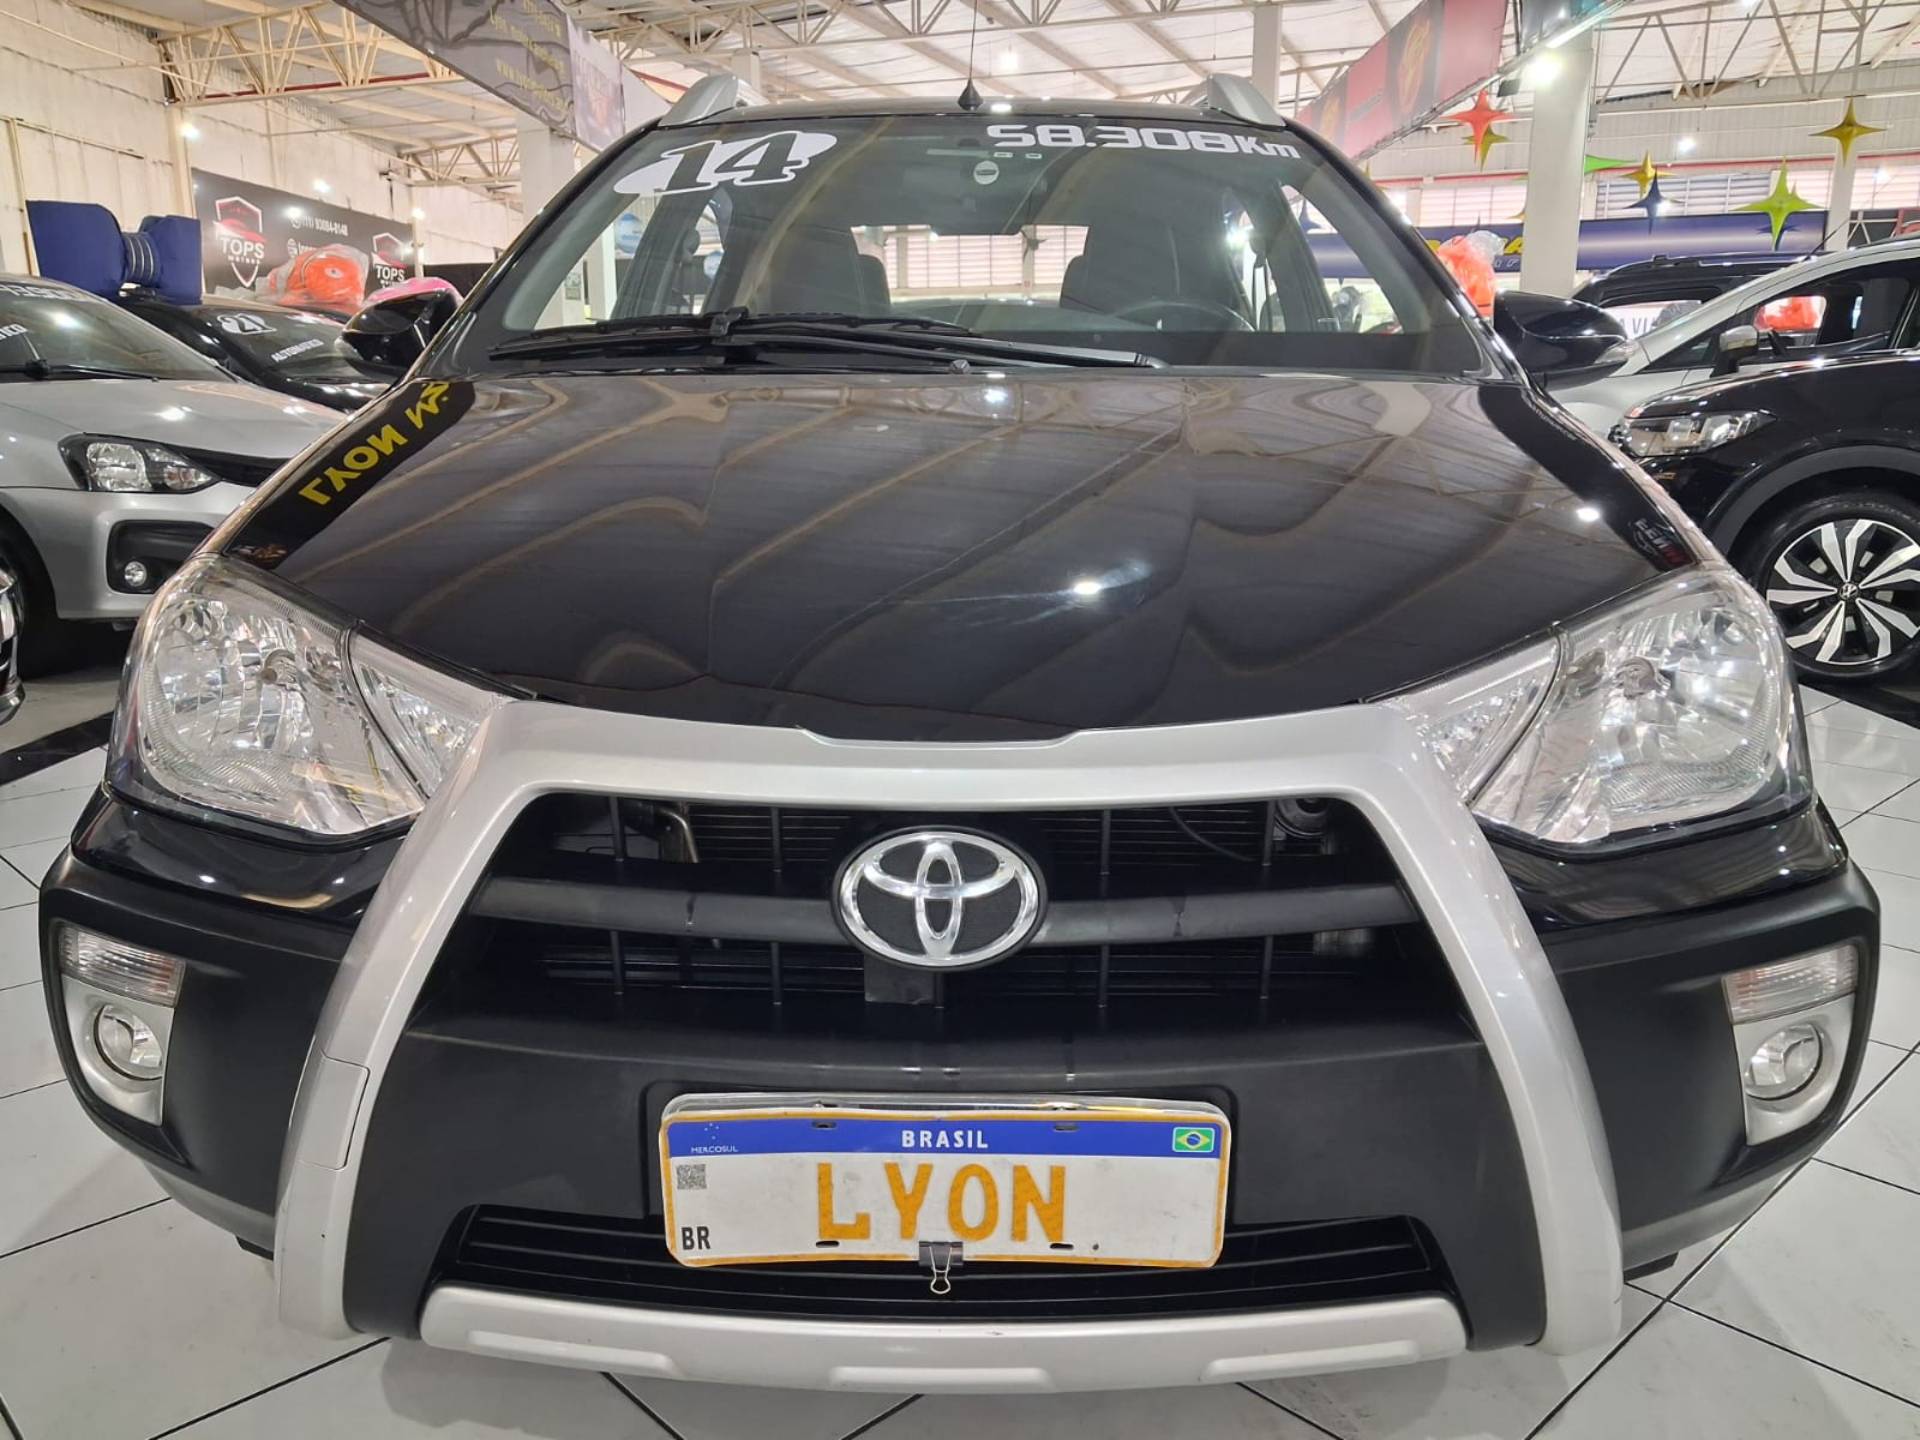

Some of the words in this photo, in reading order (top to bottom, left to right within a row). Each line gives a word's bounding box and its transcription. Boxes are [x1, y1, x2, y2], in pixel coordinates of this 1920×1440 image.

[987, 125, 1301, 158] 58.308Km
[655, 131, 812, 195] 14
[220, 236, 264, 259] TOPS
[376, 265, 405, 282] TOPS
[217, 313, 277, 335] 21
[902, 1130, 989, 1149] BRASIL
[816, 1163, 1067, 1242] LYON
[681, 1226, 712, 1251] BR
